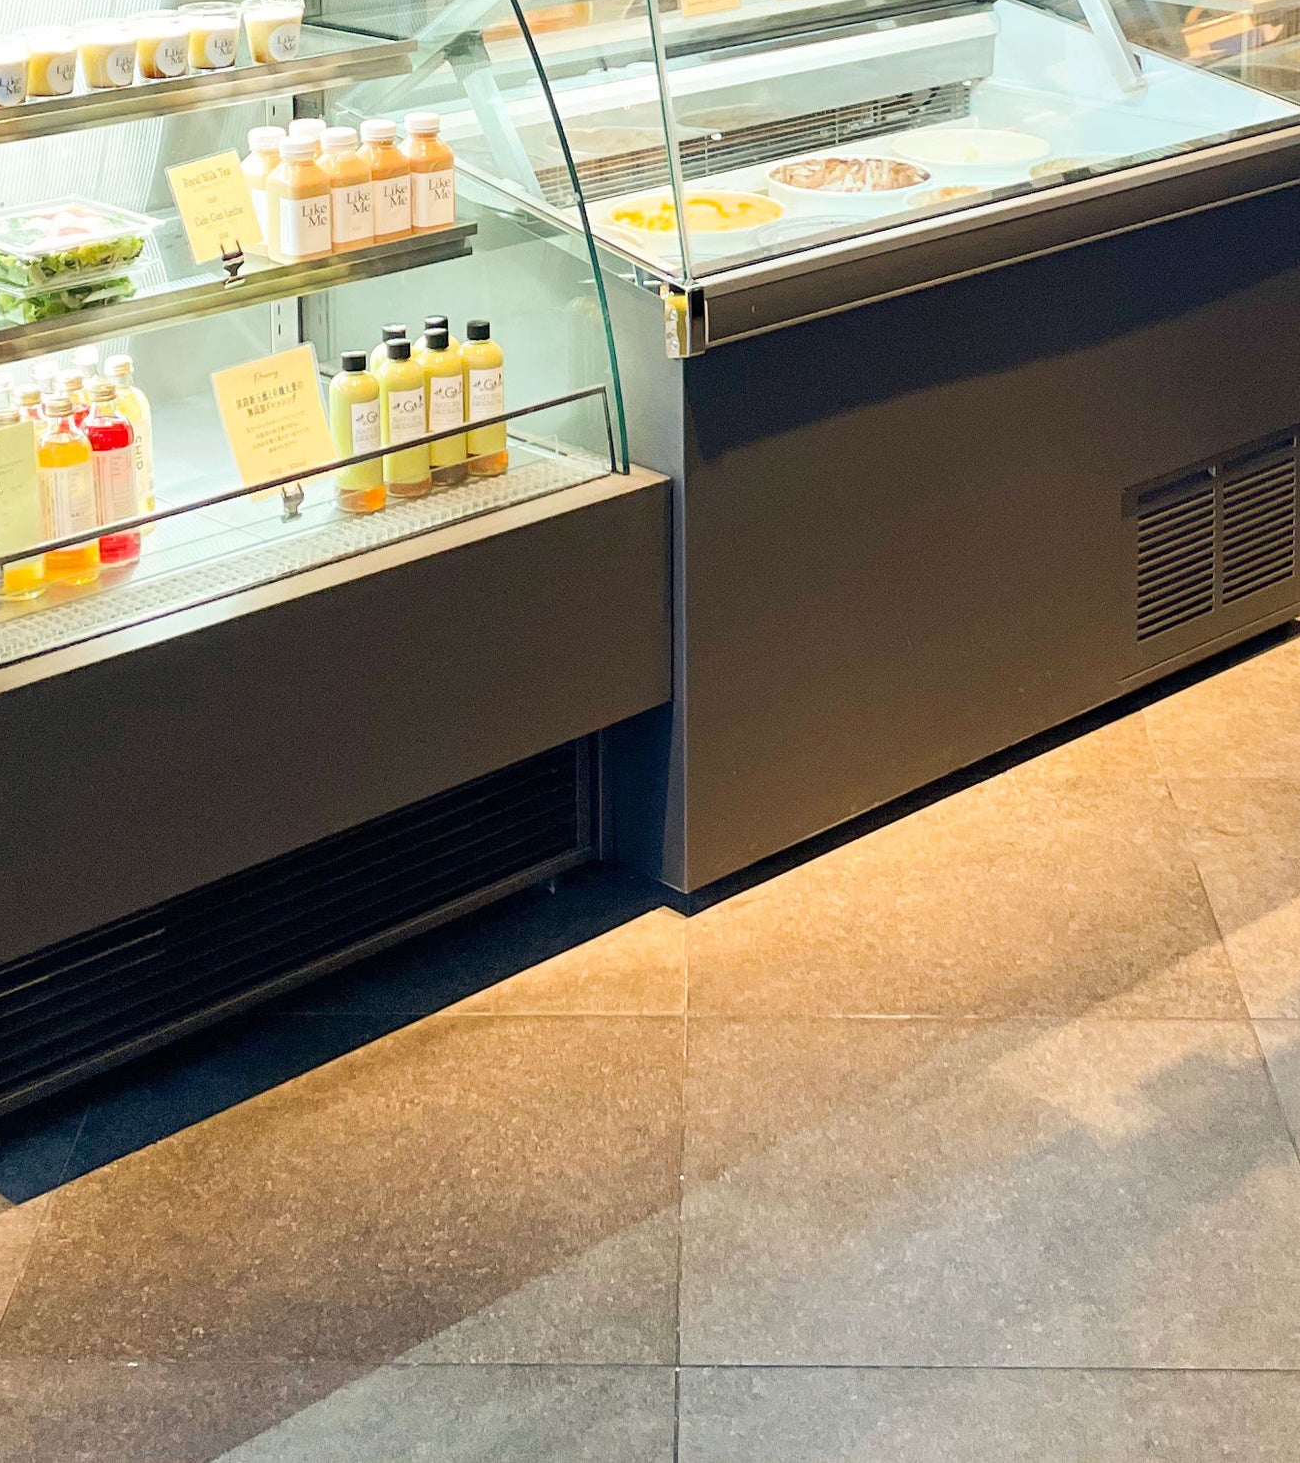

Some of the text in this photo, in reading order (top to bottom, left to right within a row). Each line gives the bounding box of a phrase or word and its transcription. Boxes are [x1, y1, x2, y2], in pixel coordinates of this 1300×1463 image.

[382, 183, 408, 198] Like
[428, 176, 451, 191] Like
[346, 190, 370, 205] Like
[434, 187, 451, 200] Me
[352, 201, 371, 214] Me
[389, 194, 408, 208] Me
[301, 203, 327, 218] Like
[308, 215, 327, 228] Me
